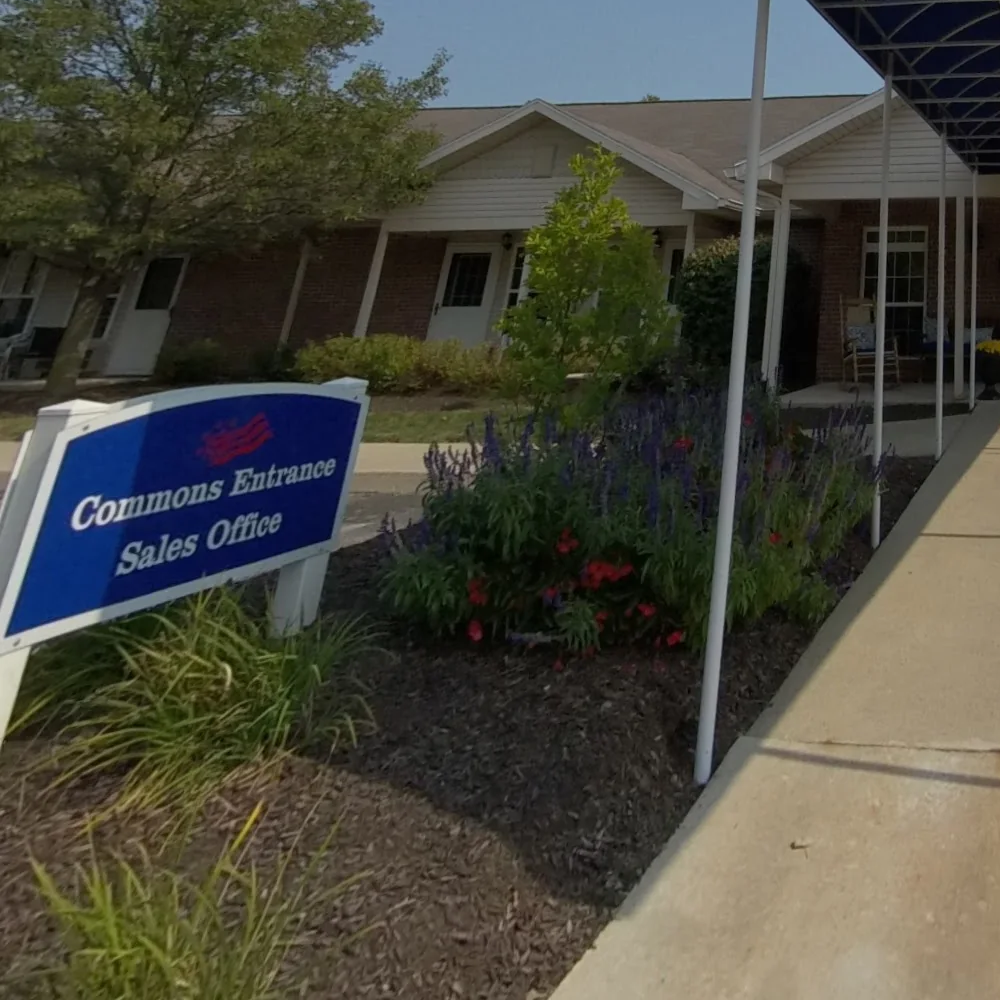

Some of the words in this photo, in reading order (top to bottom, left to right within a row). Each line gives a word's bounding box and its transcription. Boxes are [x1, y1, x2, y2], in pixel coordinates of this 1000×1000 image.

[71, 478, 223, 531] Commons
[229, 458, 336, 497] Entrance
[115, 533, 199, 576] Sales
[207, 511, 282, 550] Office
